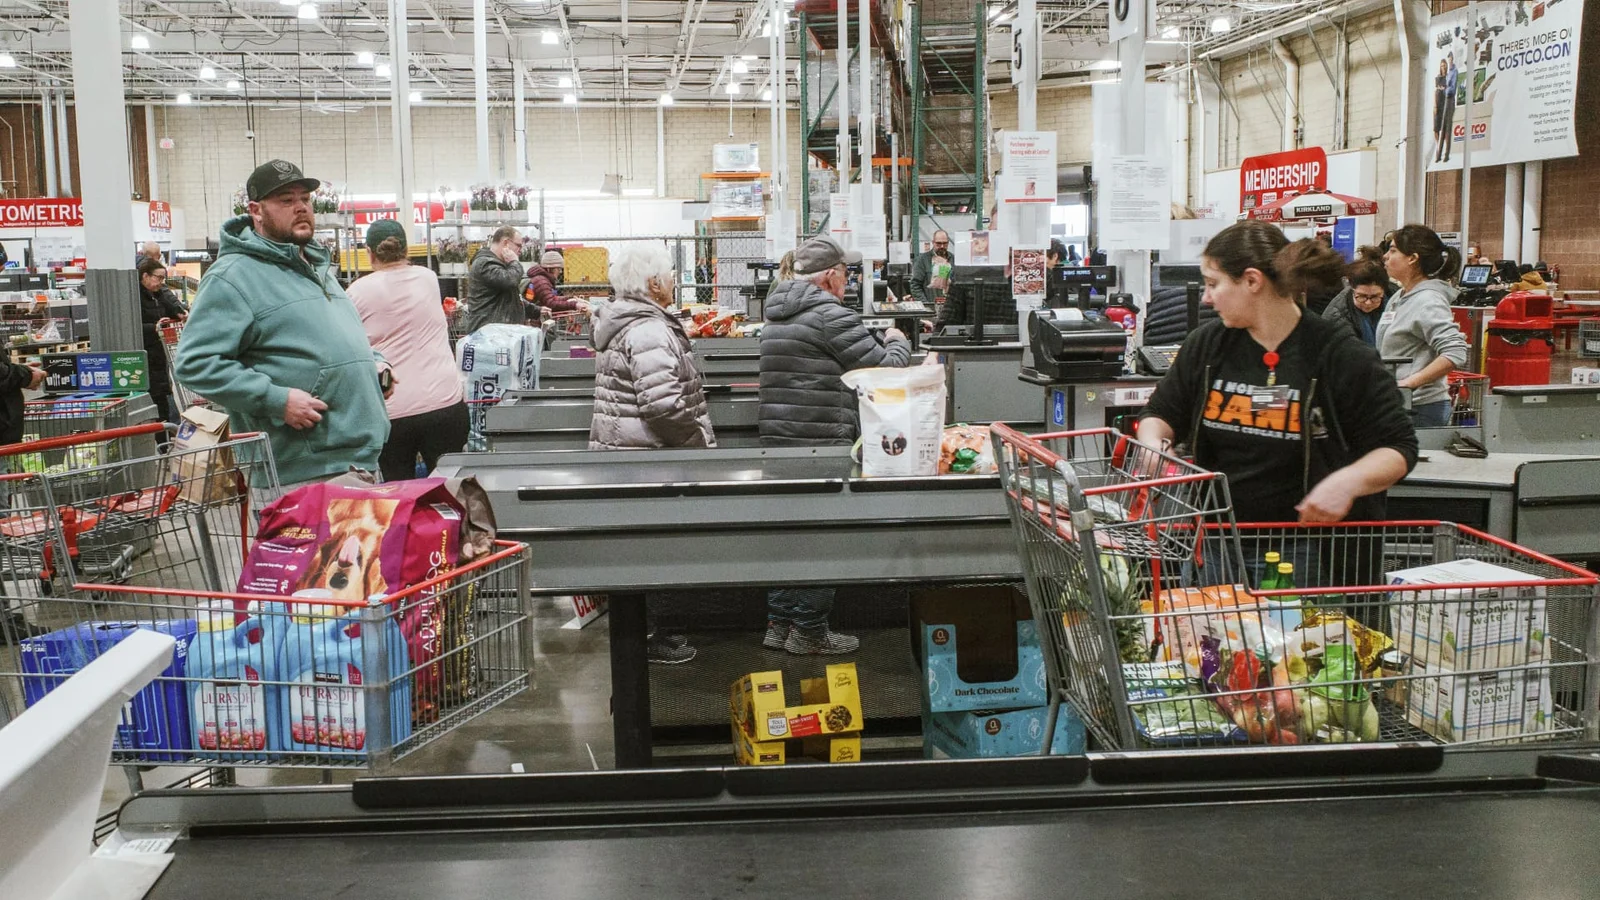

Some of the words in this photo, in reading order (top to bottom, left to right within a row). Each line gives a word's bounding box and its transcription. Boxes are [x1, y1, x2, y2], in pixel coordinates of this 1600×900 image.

[1532, 31, 1557, 46] MORE
[1014, 28, 1022, 69] 5
[1454, 123, 1486, 136] COTCO
[1245, 161, 1320, 192] MEMBERSHIP
[151, 211, 170, 227] EXAMS
[1466, 602, 1515, 618] coconut
[1472, 612, 1508, 625] water
[21, 643, 32, 652] 36
[1124, 663, 1184, 673] rthbound
[202, 692, 257, 704] ULRASOFT
[299, 685, 358, 702] ULRASOFT
[955, 687, 975, 696] Dark
[977, 686, 1020, 696] Chocolate
